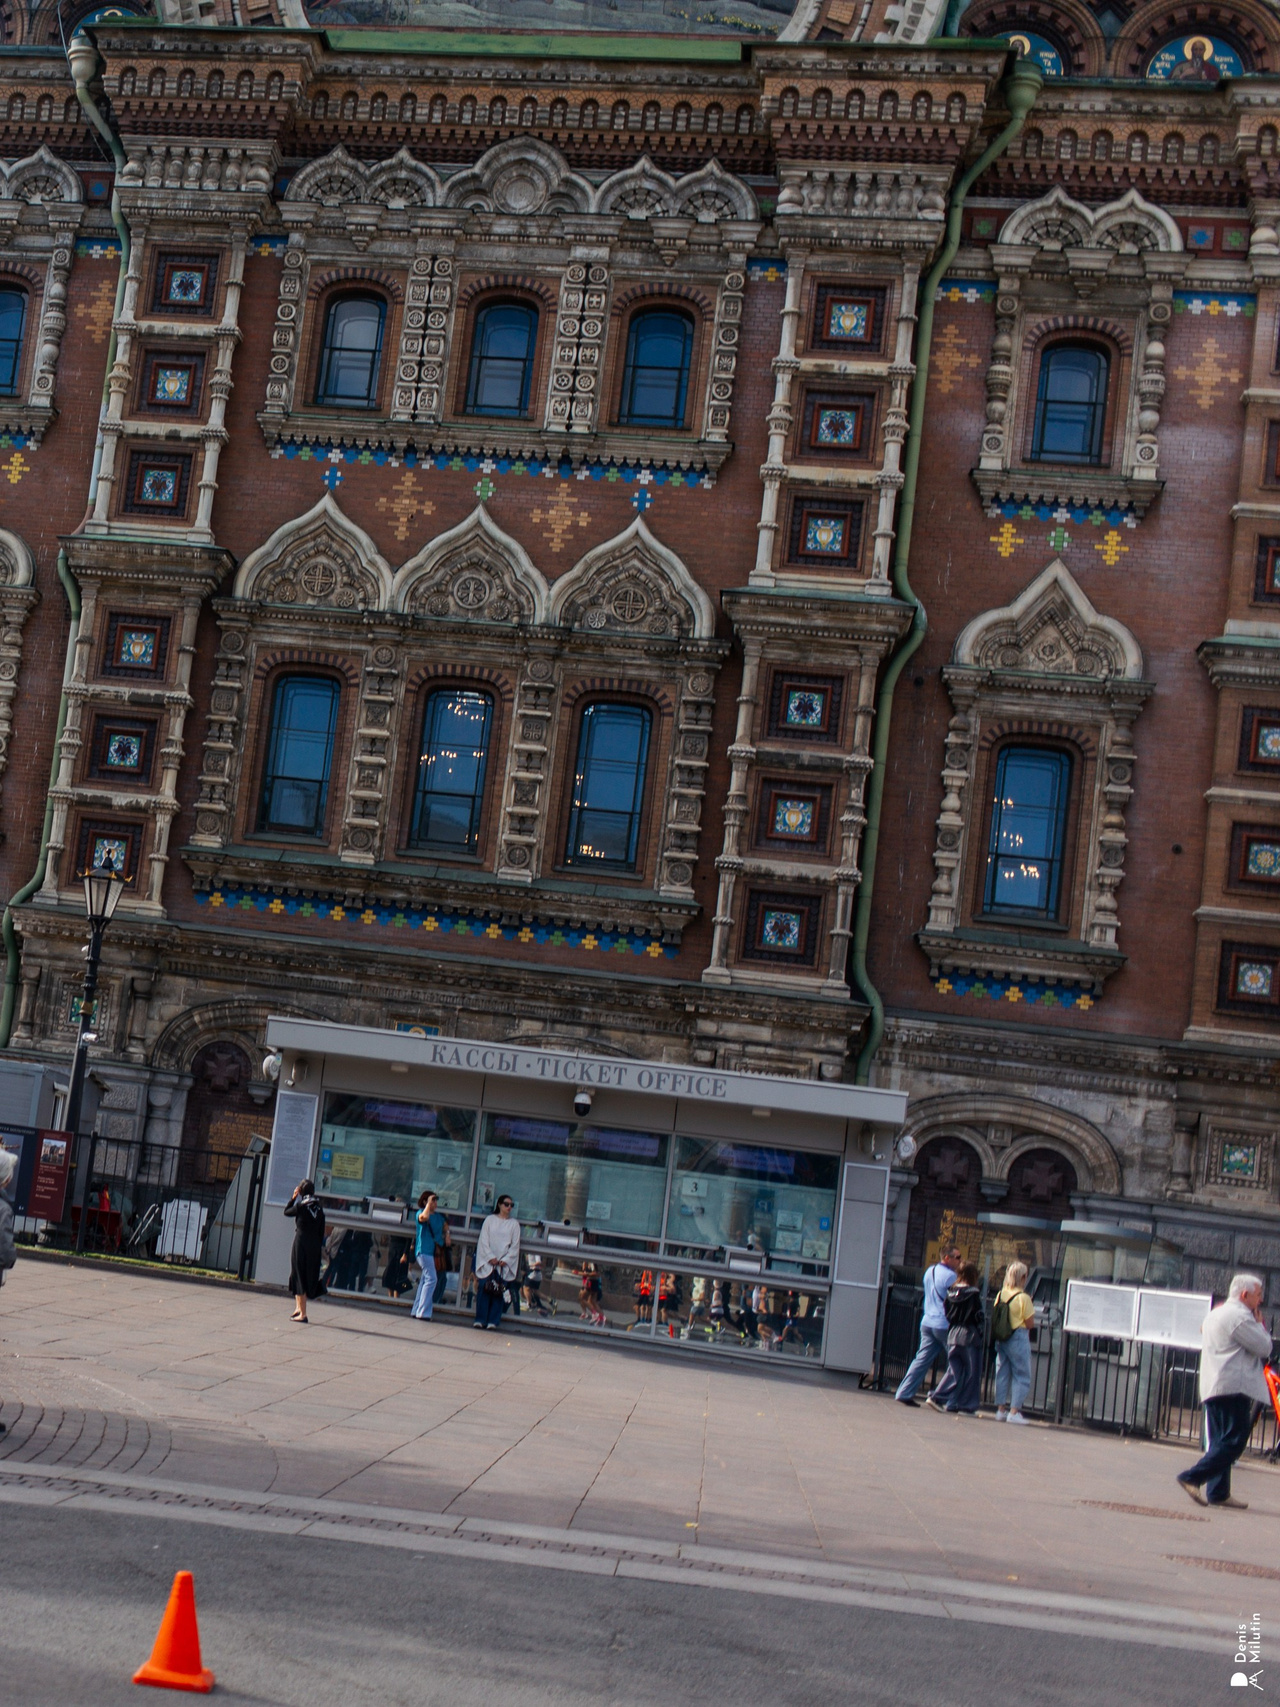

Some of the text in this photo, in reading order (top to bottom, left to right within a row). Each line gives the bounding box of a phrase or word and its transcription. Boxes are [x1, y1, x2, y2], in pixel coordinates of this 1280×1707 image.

[430, 1043, 727, 1099] КАССЫ TICKET OFFICE
[330, 1131, 336, 1143] 1
[495, 1154, 503, 1166] 2
[691, 1181, 699, 1193] 3
